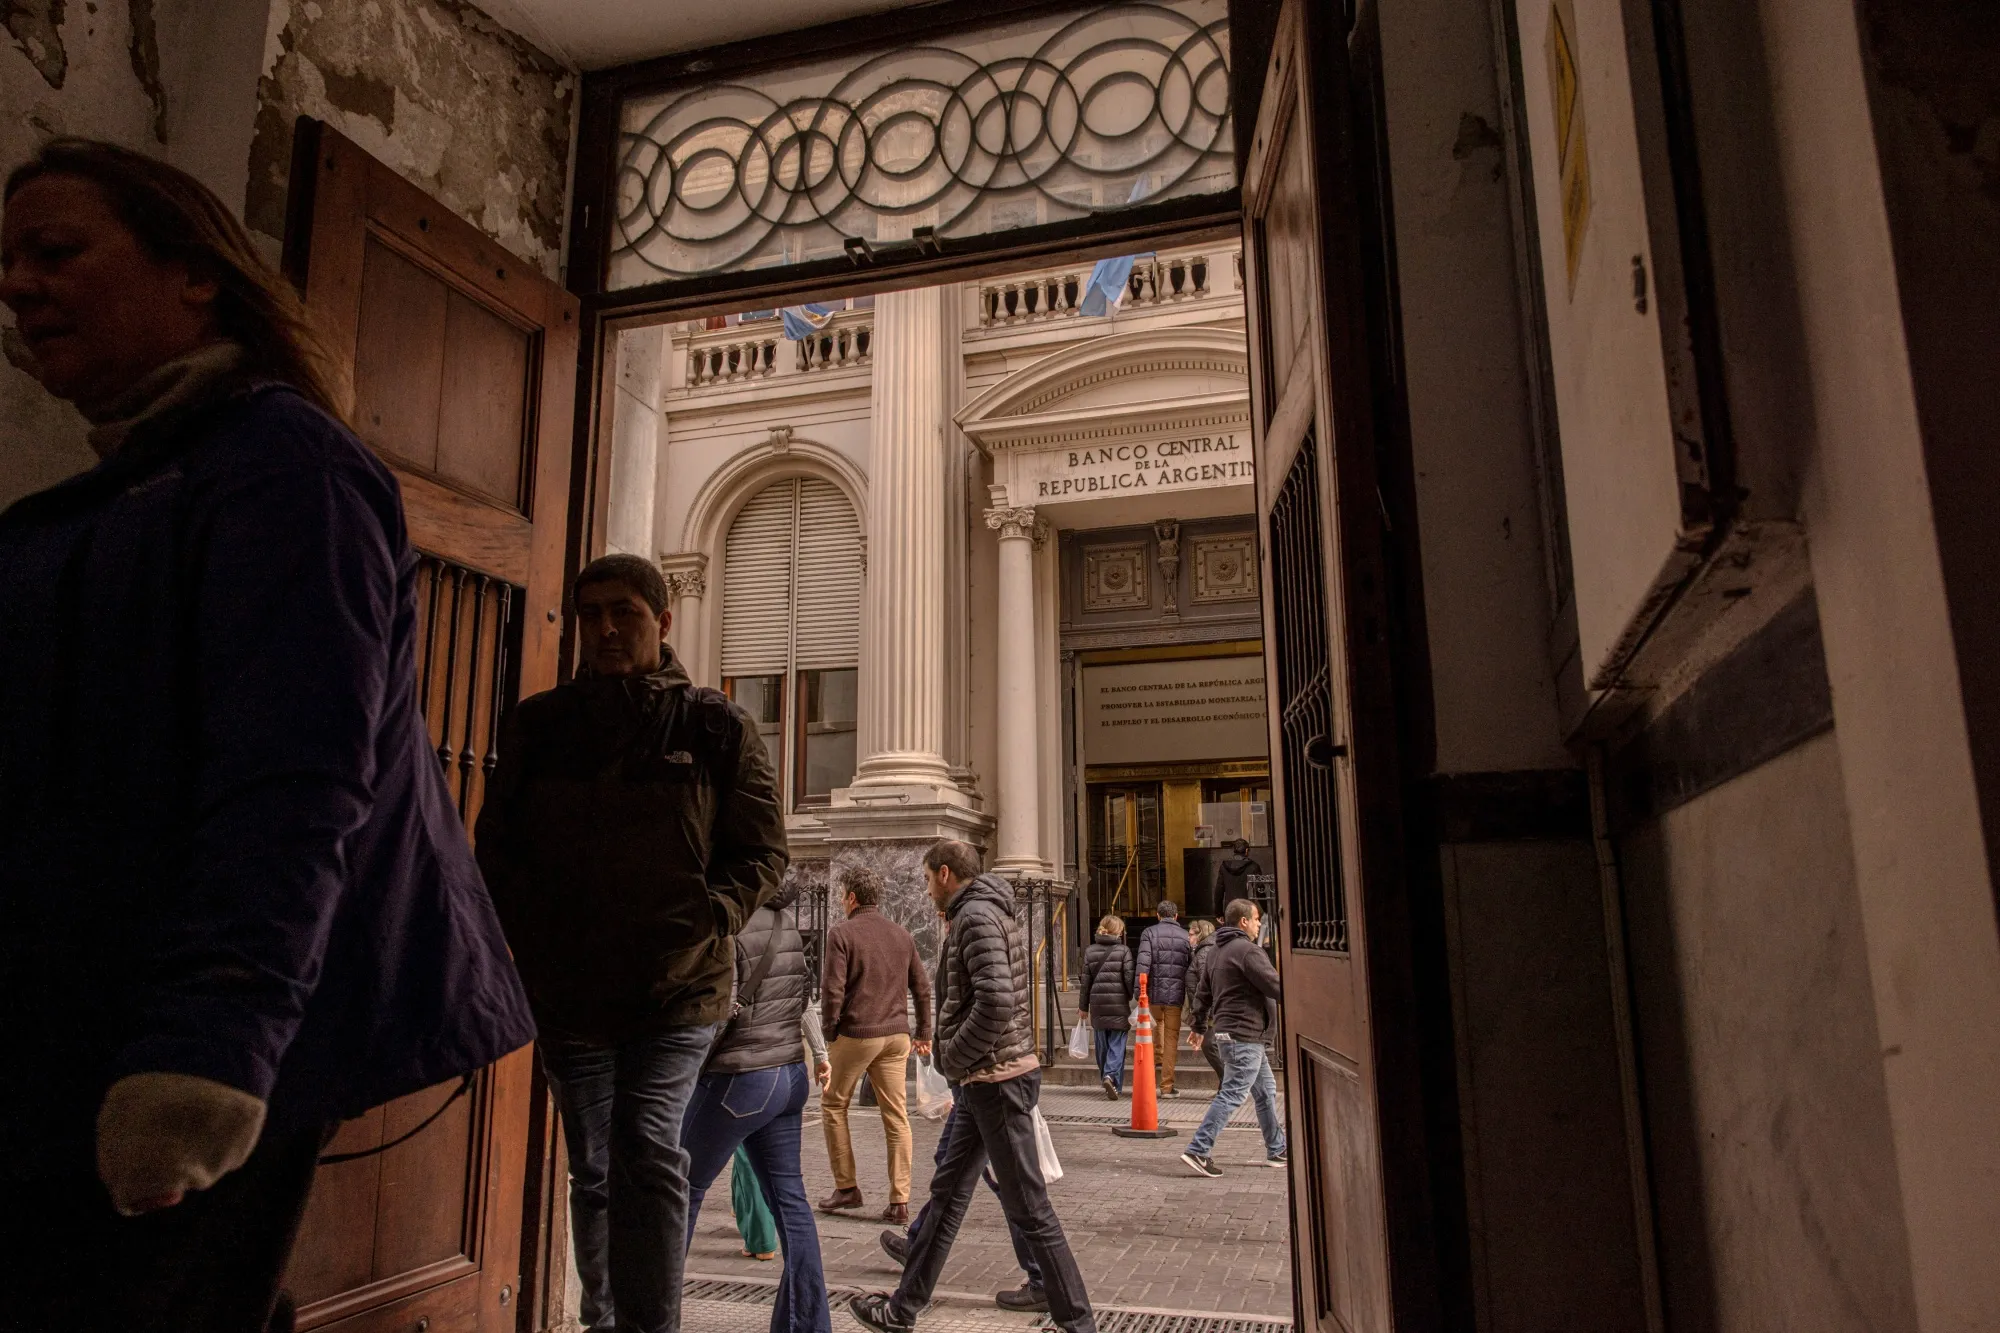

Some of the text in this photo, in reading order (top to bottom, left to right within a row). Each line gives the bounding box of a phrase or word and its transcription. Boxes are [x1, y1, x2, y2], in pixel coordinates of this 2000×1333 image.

[1068, 434, 1240, 467] BANCO CENTRAL
[1135, 459, 1170, 470] DE LA
[1038, 472, 1148, 497] REPUBLICA
[1111, 685, 1137, 693] BANCO
[1138, 683, 1173, 692] CENTRAL
[1198, 678, 1243, 688] REPÚBLICA
[1101, 702, 1143, 710] PROMOVER
[1156, 697, 1207, 707] ESTABILIDAD
[1208, 695, 1257, 704] MONETARIA,
[1112, 718, 1142, 726] EMPLEO
[1150, 717, 1160, 725] EL
[1161, 714, 1211, 724] DESARROLLO
[1213, 711, 1261, 721] ECONÓMICO
